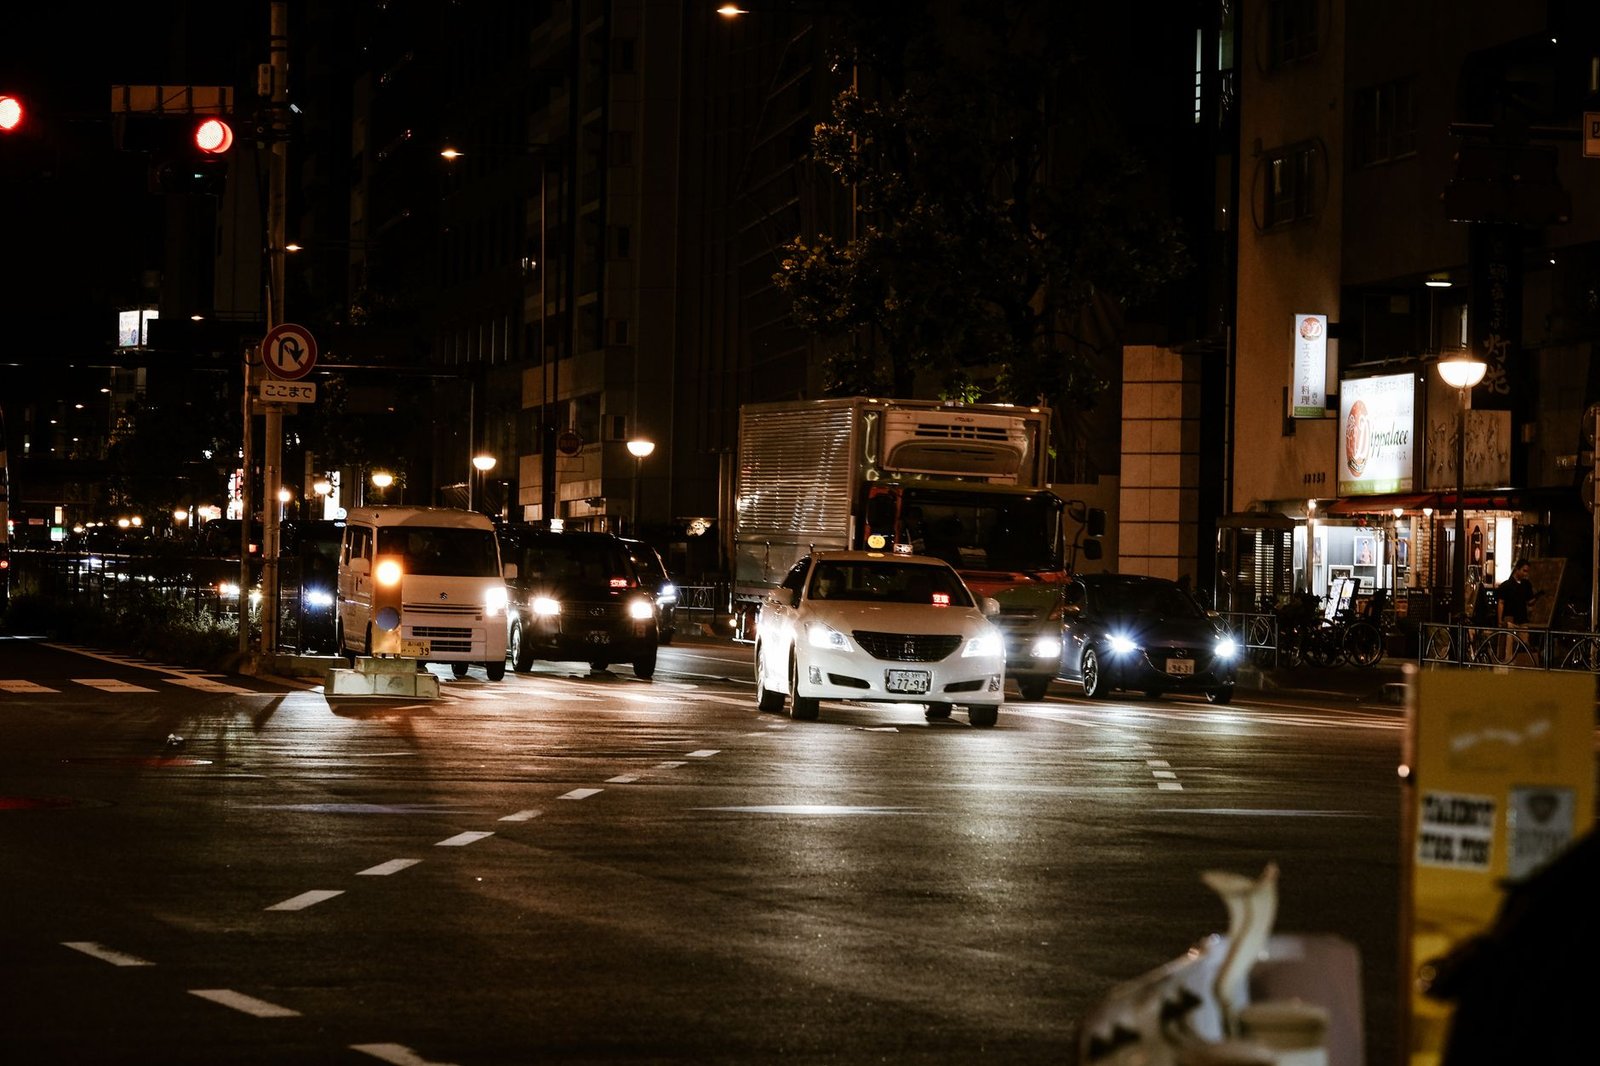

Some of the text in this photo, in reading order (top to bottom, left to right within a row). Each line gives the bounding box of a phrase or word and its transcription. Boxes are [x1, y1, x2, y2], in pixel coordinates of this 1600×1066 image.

[265, 384, 313, 399] ここまで
[1301, 343, 1311, 405] エスニック料理
